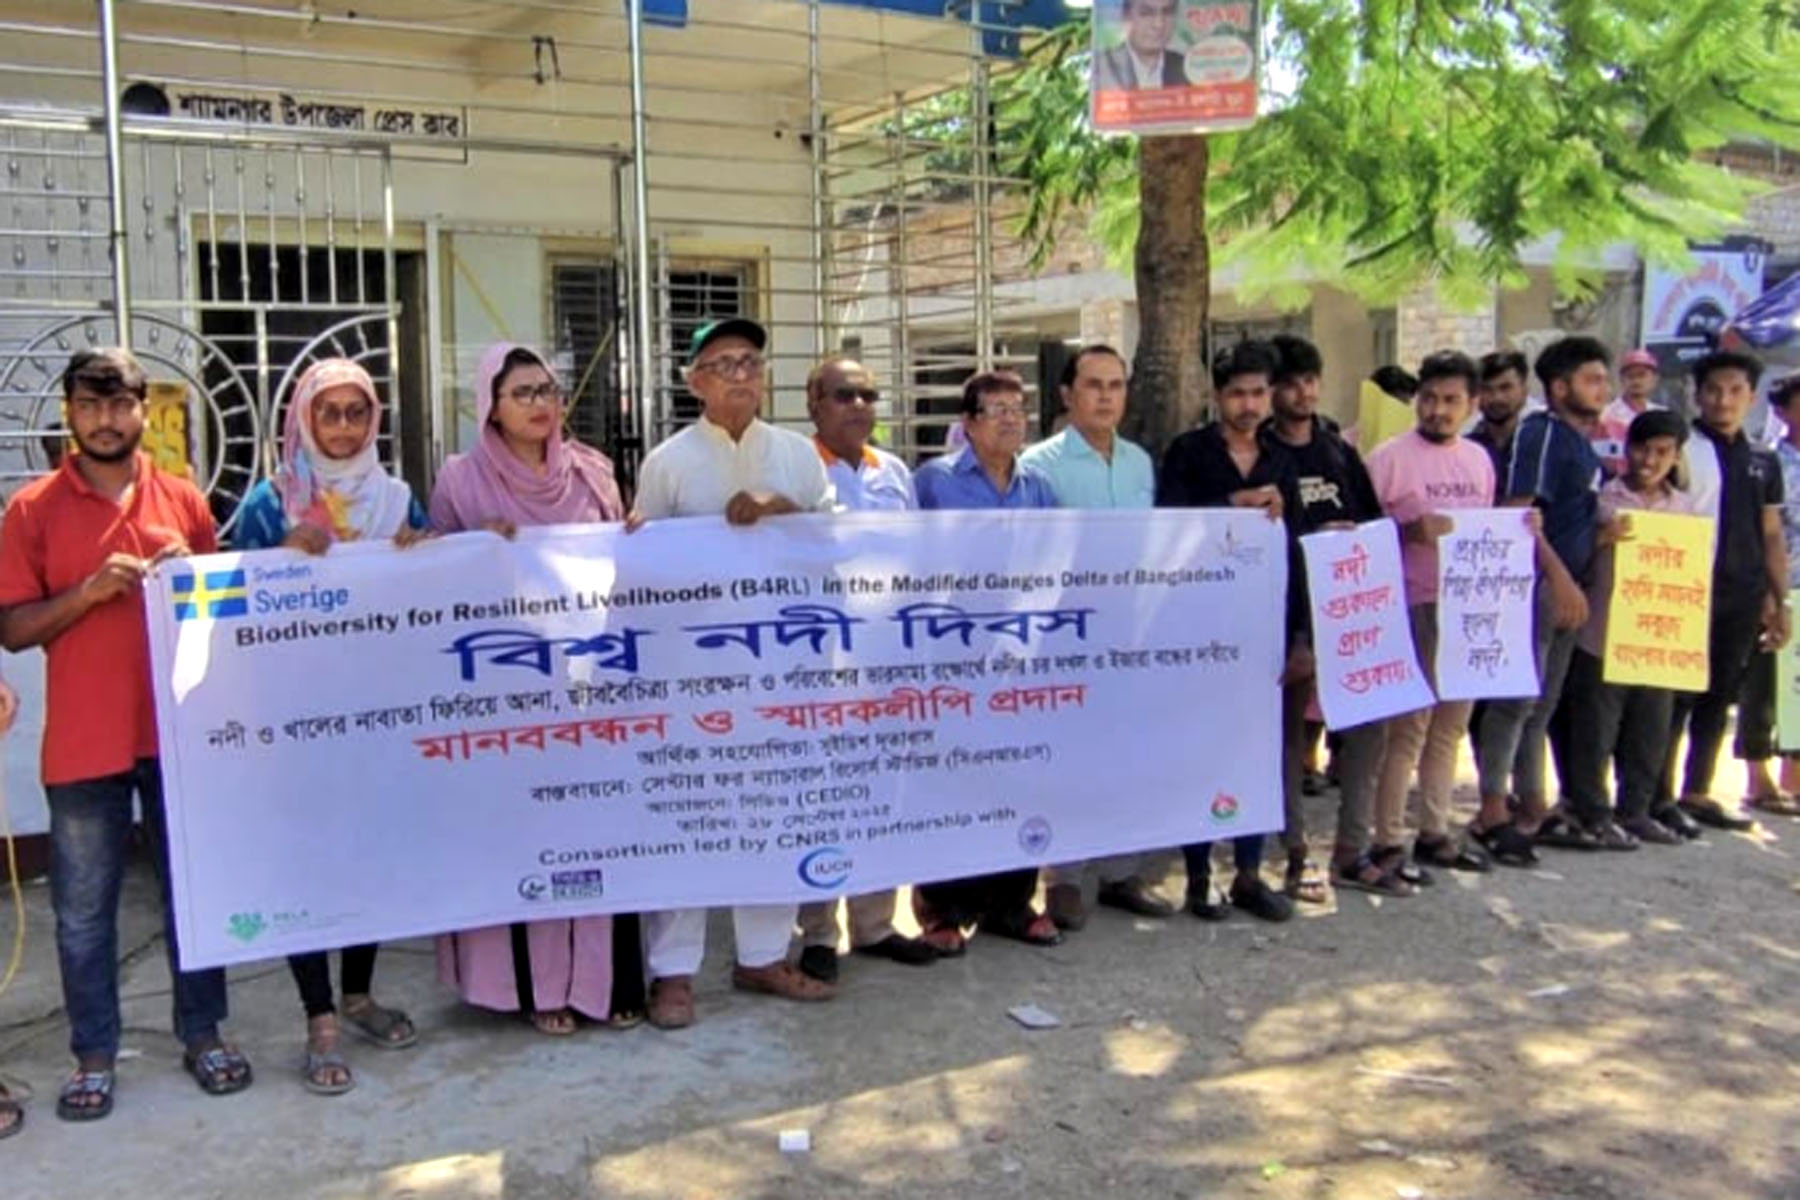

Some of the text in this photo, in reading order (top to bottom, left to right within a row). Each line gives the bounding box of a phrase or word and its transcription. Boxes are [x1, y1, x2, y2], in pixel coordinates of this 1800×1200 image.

[177, 94, 272, 123] শ্যামনগর
[279, 94, 365, 130] উপজেলা
[374, 109, 415, 134] প্রেস
[253, 565, 312, 582] Sweden
[1330, 544, 1370, 585] নদী
[236, 567, 1236, 647] Biodiversity for Resilient Livelihoods (B4RL) in the Modified Ganges Delta of Bangladesh
[255, 586, 348, 613] Sverige
[440, 602, 1097, 682] বিশ্ব নদী দিবস
[1337, 626, 1383, 656] প্রাণ
[207, 720, 246, 749] নদী
[257, 726, 274, 746] ও
[283, 715, 347, 742] খালের
[355, 703, 423, 732] নাব্যতা
[430, 693, 497, 722] ফিরিয়ে
[506, 689, 560, 714] আনা,
[761, 674, 776, 692] ও
[784, 664, 858, 690] পরিবেশের
[413, 684, 1088, 763] মানববন্ধন ও স্মারকলীপি প্রদান
[637, 744, 700, 767] আর্থিক
[641, 771, 704, 794] সেন্টার
[714, 770, 744, 788] ফর
[797, 784, 870, 808] (CEDIO)
[539, 807, 1016, 866] Consortium led by CNRS in partnership with
